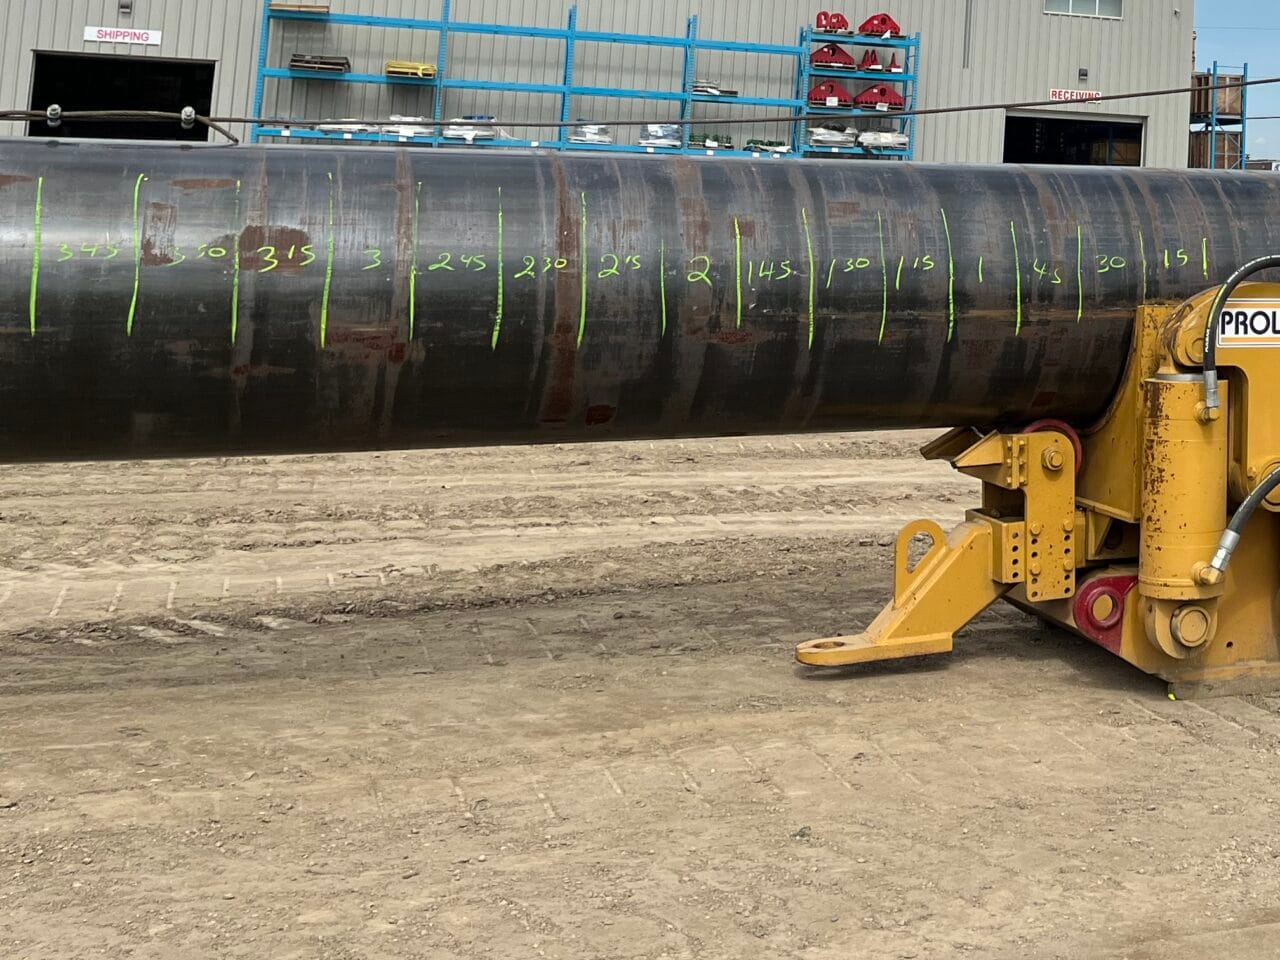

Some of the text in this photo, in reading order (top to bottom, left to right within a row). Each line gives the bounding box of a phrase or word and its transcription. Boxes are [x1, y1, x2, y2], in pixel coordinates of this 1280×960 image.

[96, 29, 150, 42] SHIPPING
[1051, 90, 1100, 100] RECEIVING
[256, 244, 316, 273] 315
[362, 249, 381, 271] 3
[428, 252, 487, 272] 245
[514, 255, 567, 278] 230
[687, 255, 713, 288] 2
[748, 260, 792, 286] 145
[826, 258, 870, 289] 130
[896, 255, 935, 290] 115
[1033, 257, 1063, 284] 45
[1095, 254, 1127, 273] 30
[1164, 248, 1189, 269] 15
